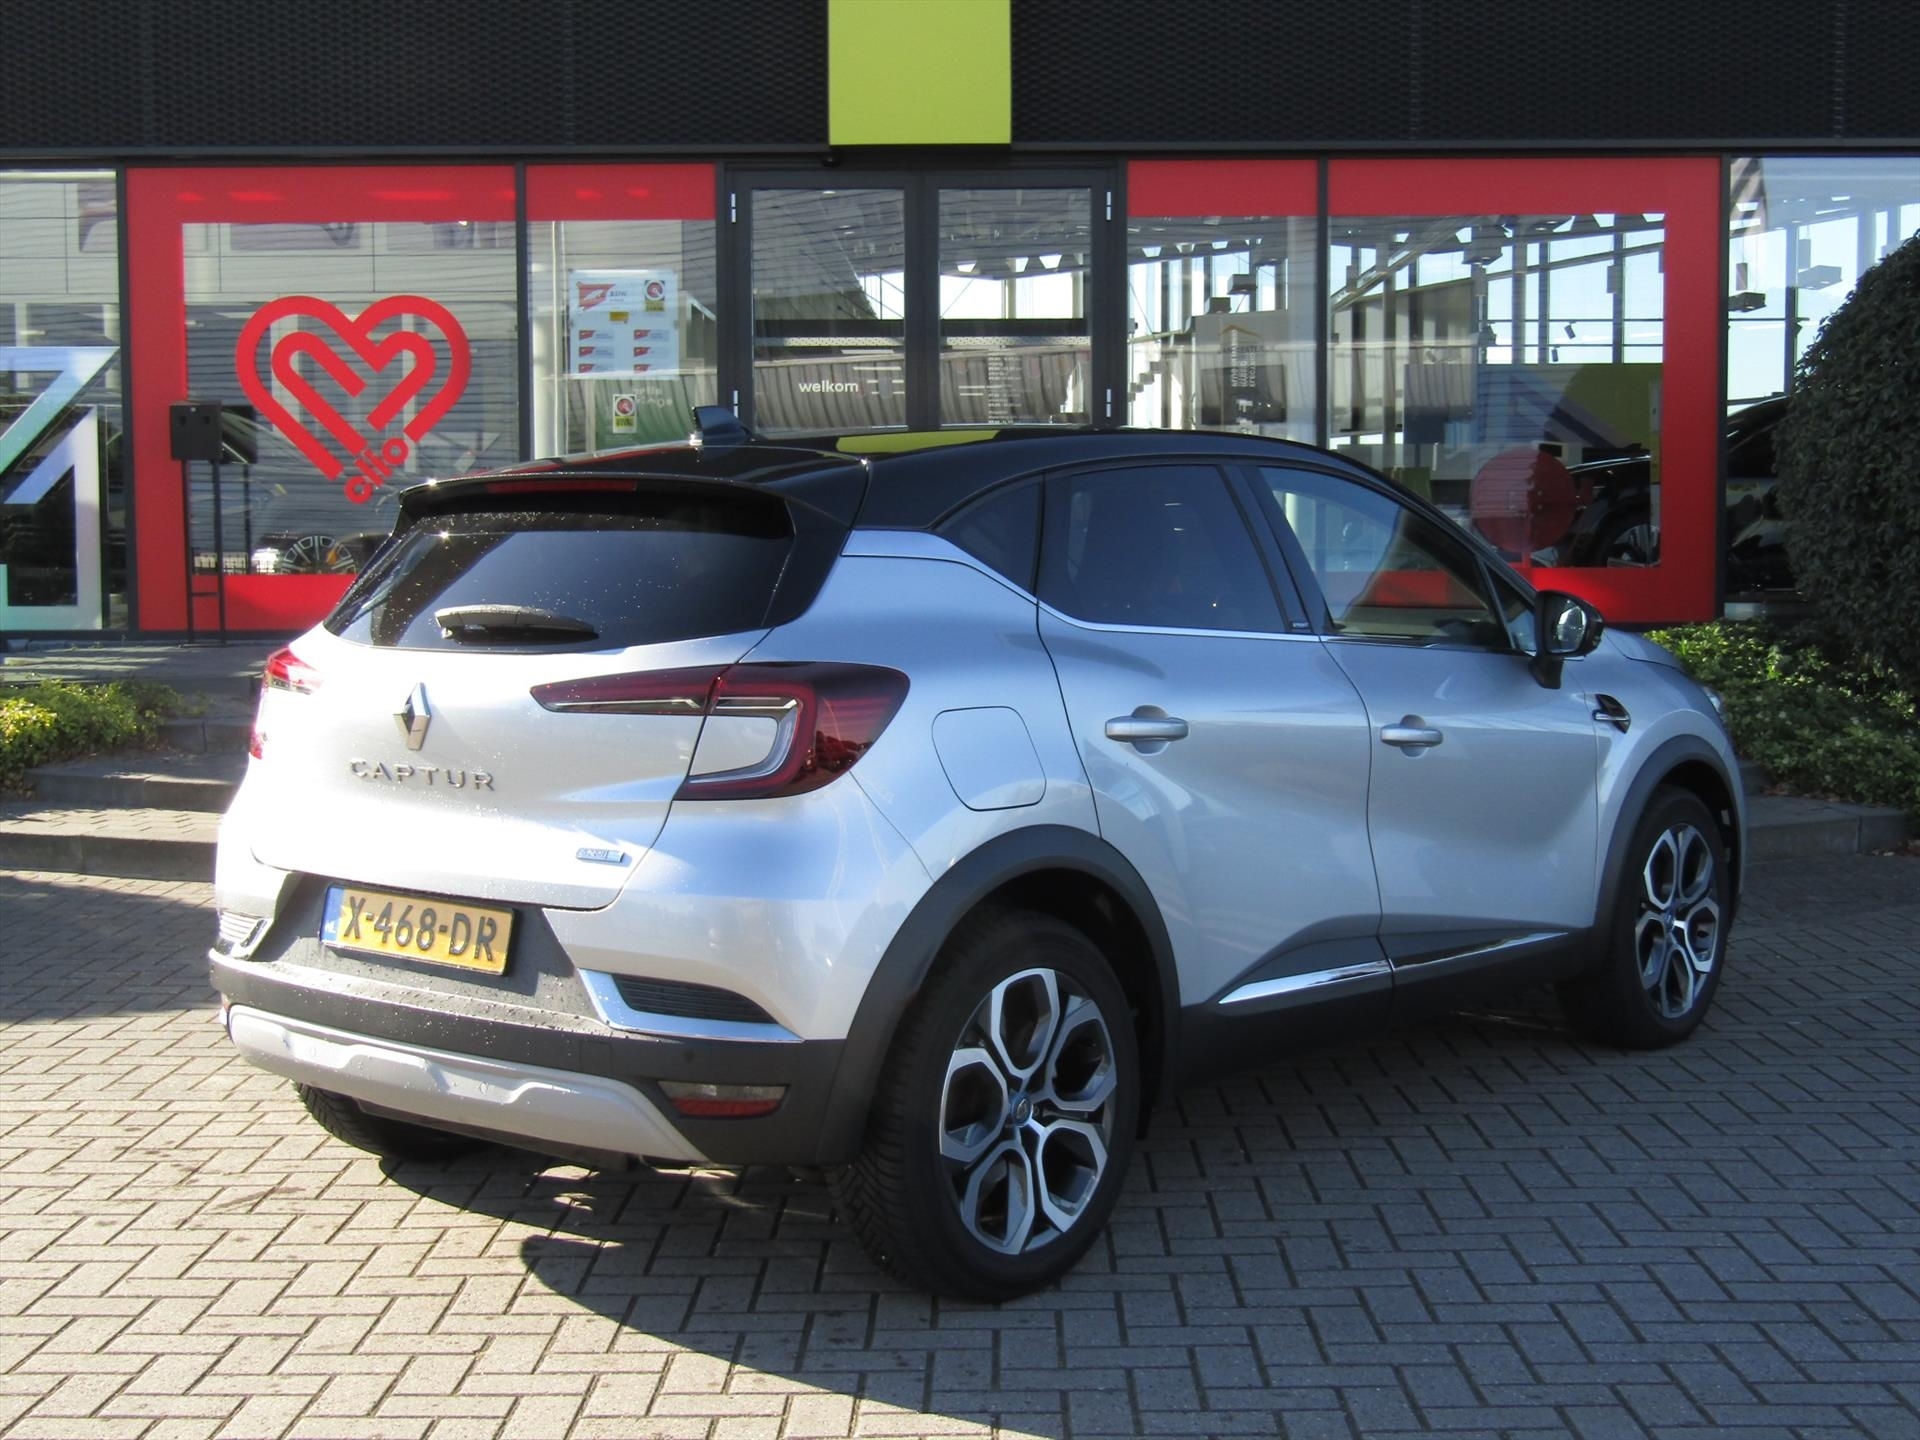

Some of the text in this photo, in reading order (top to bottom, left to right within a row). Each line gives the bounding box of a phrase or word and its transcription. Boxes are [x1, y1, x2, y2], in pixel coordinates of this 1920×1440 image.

[799, 379, 859, 393] welkom
[350, 758, 495, 791] CAPTUR
[344, 896, 498, 961] X-468-DR
